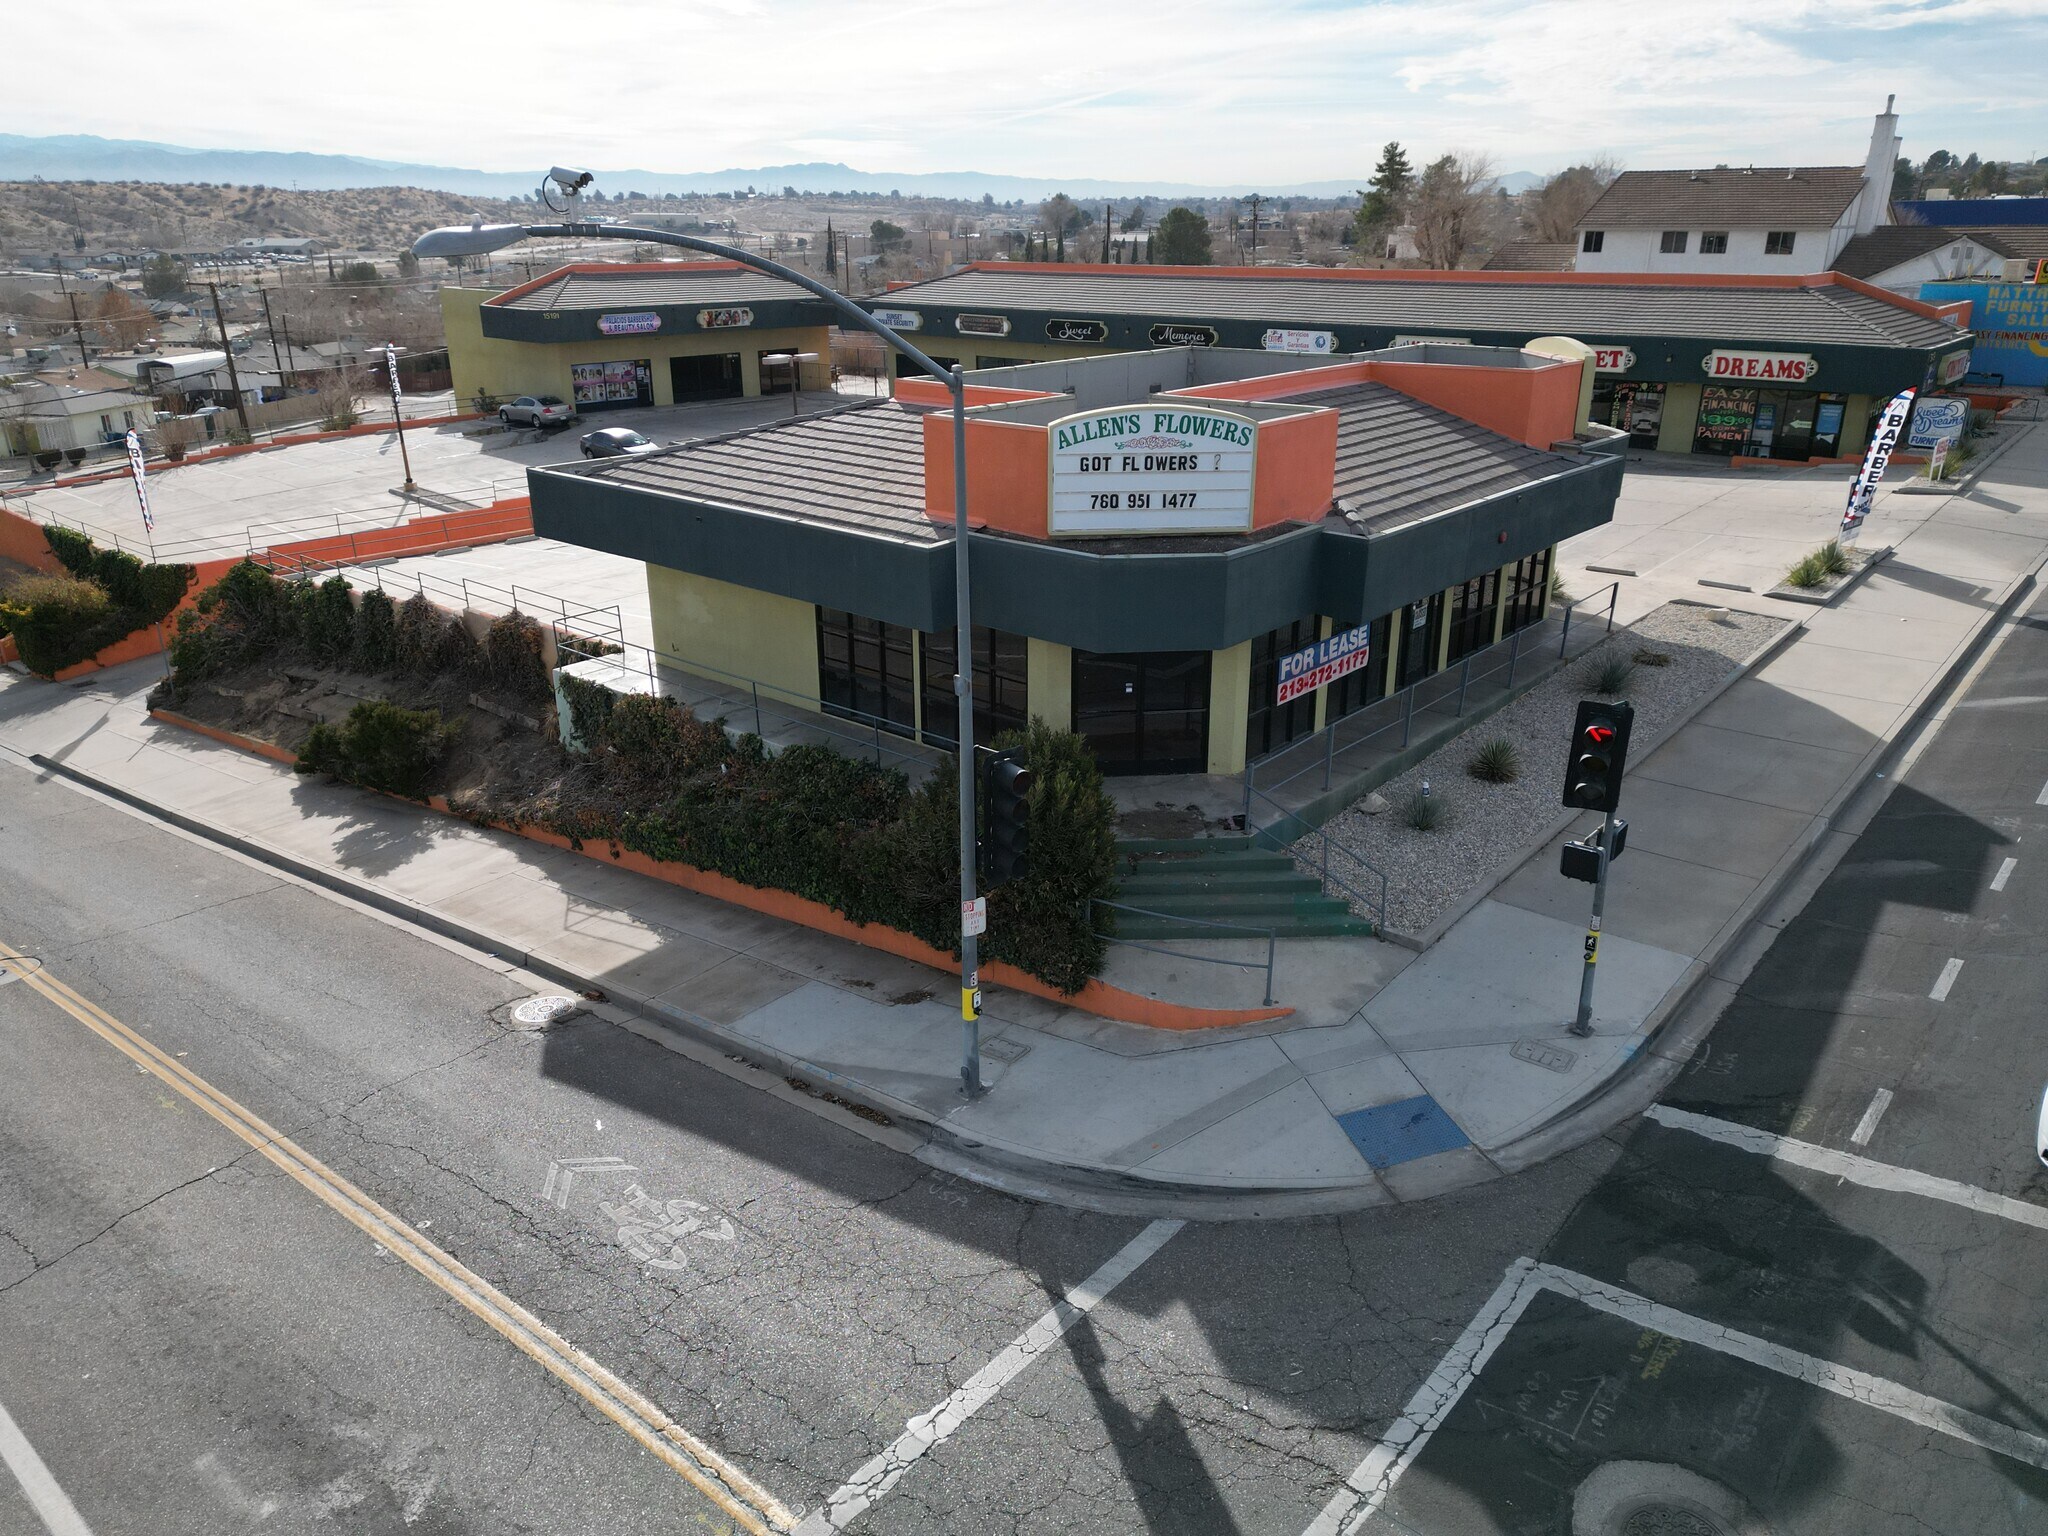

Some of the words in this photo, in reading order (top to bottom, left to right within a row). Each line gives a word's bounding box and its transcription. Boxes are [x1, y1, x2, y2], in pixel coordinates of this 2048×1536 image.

[614, 323, 636, 332] BEAUTY
[636, 322, 654, 330] SALON
[893, 319, 914, 327] SECURITY
[1058, 322, 1092, 340] Sweet
[1158, 327, 1206, 345] Memories
[1714, 356, 1806, 380] DREAMS
[1703, 387, 1755, 400] EASY
[1700, 399, 1756, 414] FINANCING
[1913, 405, 1949, 427] Sweet
[1914, 416, 1964, 434] Dreams
[1058, 414, 1141, 450] ALLEN'S
[1153, 413, 1253, 447] FLOWERS
[1697, 426, 1752, 441] PAYMENT
[1910, 435, 1958, 448] FURNITRE
[1079, 456, 1112, 472] GOT
[1122, 454, 1198, 472] FLOWERS
[1861, 414, 1903, 498] BARBER
[1090, 493, 1119, 509] 760
[1127, 494, 1150, 509] 951
[1162, 493, 1197, 509] 1477
[1280, 647, 1315, 681] FOR
[1319, 624, 1368, 663] LEASE
[1279, 648, 1367, 702] 213-272-1177
[963, 902, 974, 912] NO
[964, 910, 985, 921] STOPPING
